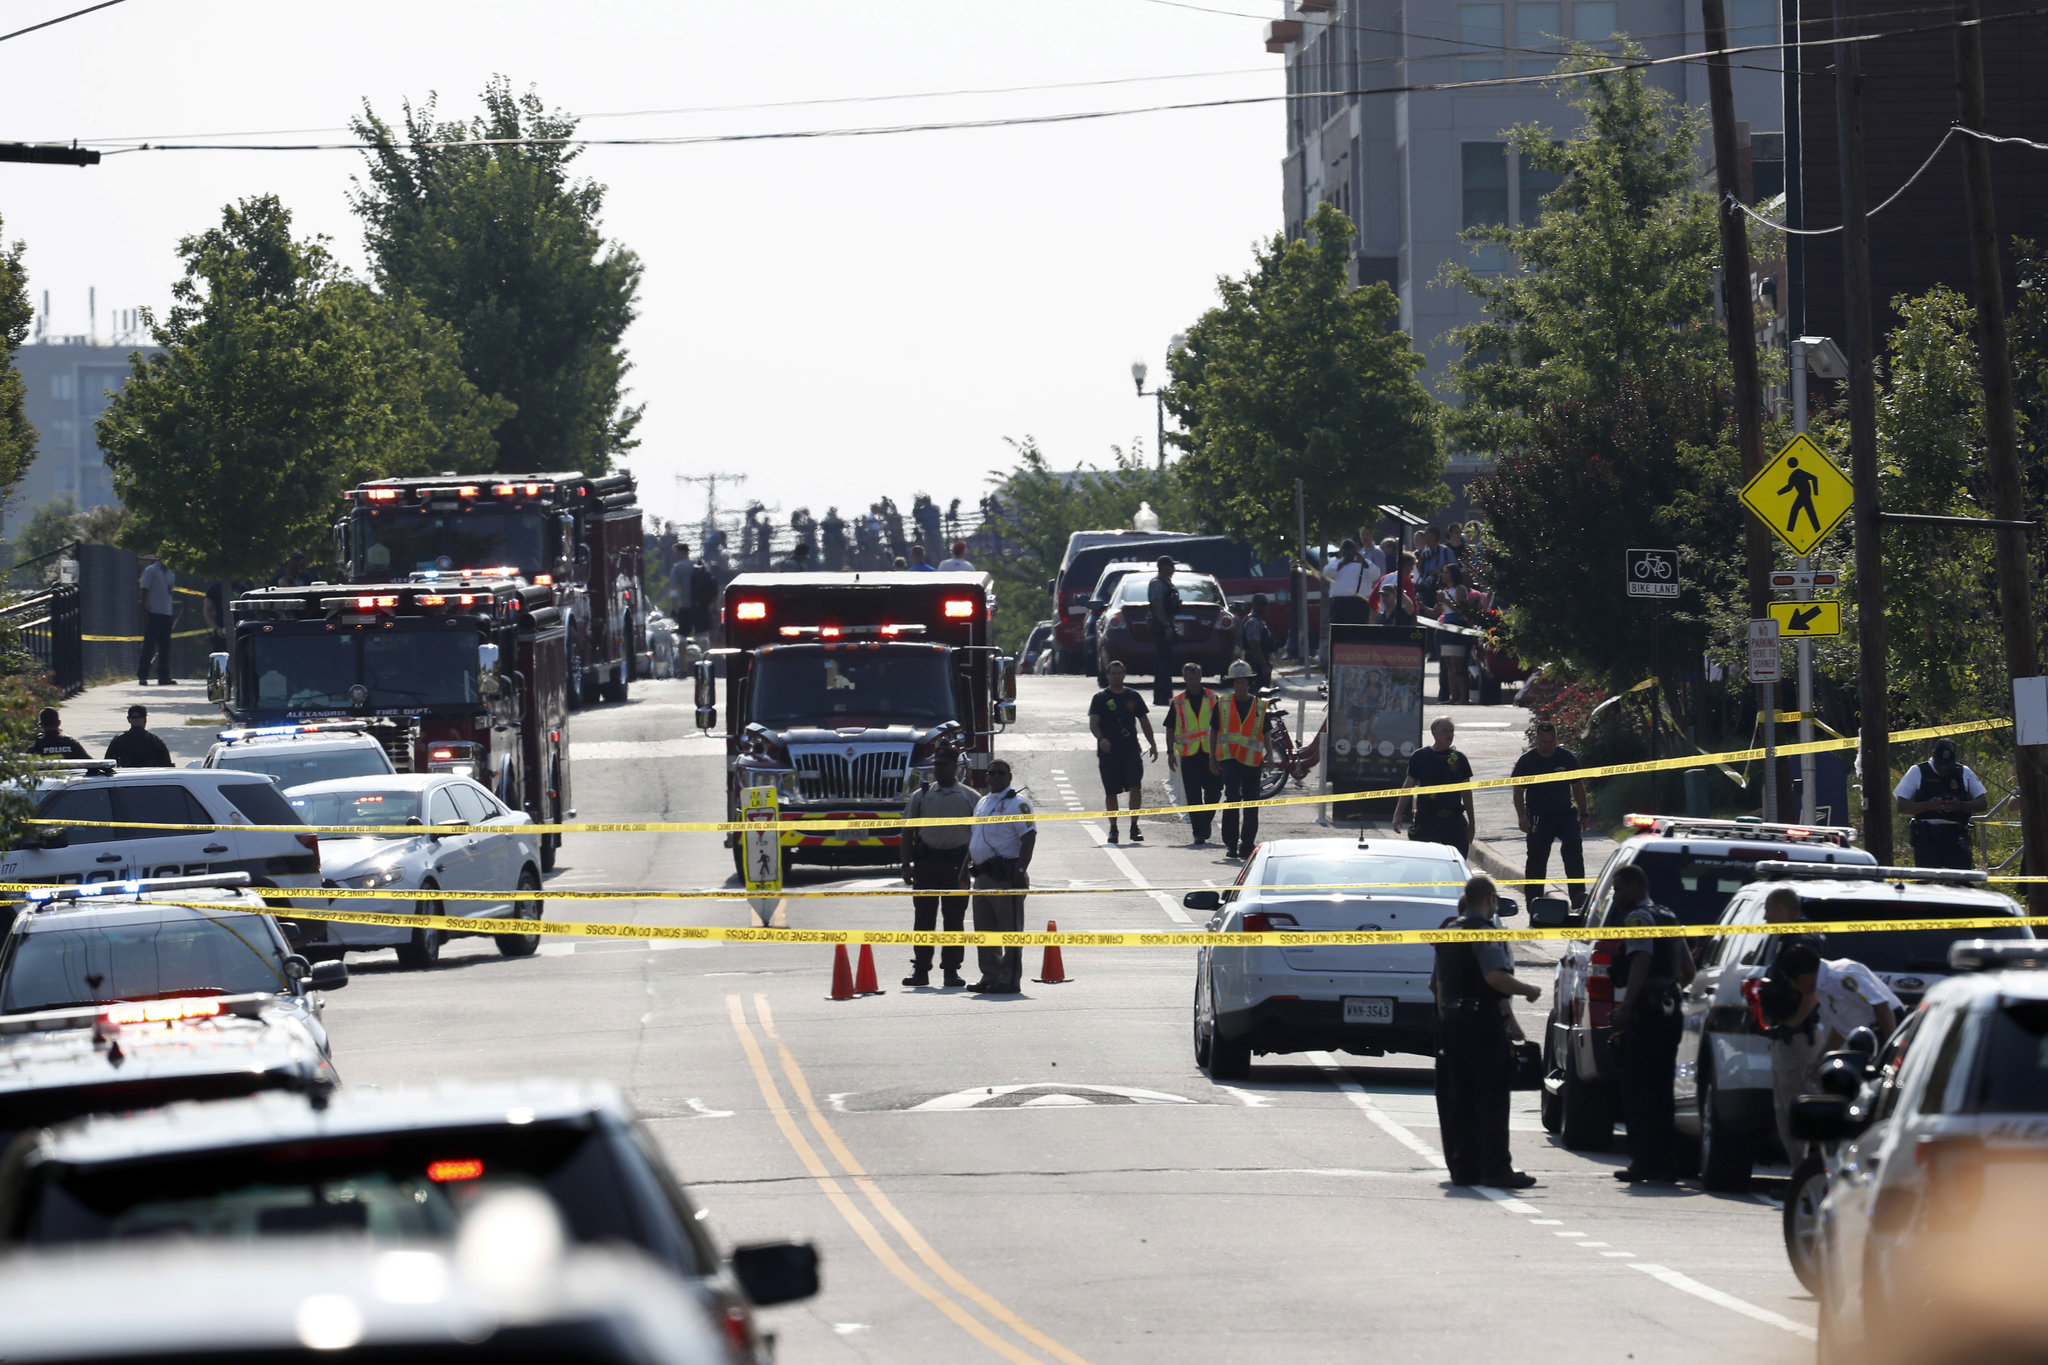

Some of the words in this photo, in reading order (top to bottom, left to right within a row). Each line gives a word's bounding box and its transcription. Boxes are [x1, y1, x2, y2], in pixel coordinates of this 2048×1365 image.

[1631, 583, 1651, 593] BIKE
[1654, 584, 1676, 594] LANE
[1758, 626, 1768, 636] NO
[1752, 638, 1776, 648] PARKING
[1752, 649, 1766, 658] HERE
[1769, 649, 1776, 658] TO
[1754, 659, 1775, 668] CORNER
[286, 710, 347, 718] ALEXANDRIA
[43, 746, 72, 754] POLICE
[1, 862, 18, 874] 1717
[316, 889, 346, 897] SCENE
[307, 911, 338, 921] CROSS
[338, 912, 358, 922] NOT
[358, 914, 368, 922] DO
[370, 914, 401, 924] SCENE
[404, 916, 431, 926] CRIME
[446, 918, 477, 930] CROSS
[478, 920, 497, 931] NOT
[500, 921, 510, 931] DO
[512, 922, 540, 932] SCENE
[542, 923, 571, 934] CRIME
[585, 924, 617, 935] CROSS
[618, 926, 636, 937] NOT
[638, 927, 651, 937] DO
[652, 927, 682, 938] SCENE
[682, 928, 709, 938] CRIME
[725, 929, 756, 940] CROSS
[1560, 930, 1590, 939] CROSS
[1627, 929, 1657, 938] SCENE
[1659, 928, 1687, 937] CRIME
[756, 930, 774, 940] NOT
[776, 930, 789, 941] DO
[790, 931, 819, 942] SCENE
[820, 931, 848, 942] CRIME
[863, 932, 894, 943] CROSS
[895, 933, 913, 943] NOT
[914, 933, 927, 943] DO
[929, 933, 956, 944] SCENE
[959, 934, 986, 944] CRIME
[1002, 934, 1032, 945] CROSS
[1034, 934, 1052, 945] NOT
[1052, 934, 1065, 945] DO
[1067, 934, 1095, 945] SCENE
[1097, 934, 1124, 944] CRIME
[1139, 934, 1170, 945] CROSS
[1172, 934, 1190, 944] NOT
[1190, 934, 1204, 944] DO
[1205, 934, 1235, 944] SCENE
[1236, 934, 1263, 944] CRIME
[1279, 934, 1310, 944] CROSS
[1312, 934, 1330, 944] NOT
[1330, 934, 1343, 944] DO
[1345, 934, 1375, 943] SCENE
[1376, 933, 1403, 942] CRIME
[1419, 932, 1450, 942] CROSS
[1452, 932, 1470, 941] NOT
[1470, 932, 1484, 941] DO
[1486, 931, 1514, 941] SCENE
[1516, 931, 1544, 940] CRIME
[1347, 1005, 1390, 1018] WNN-3543
